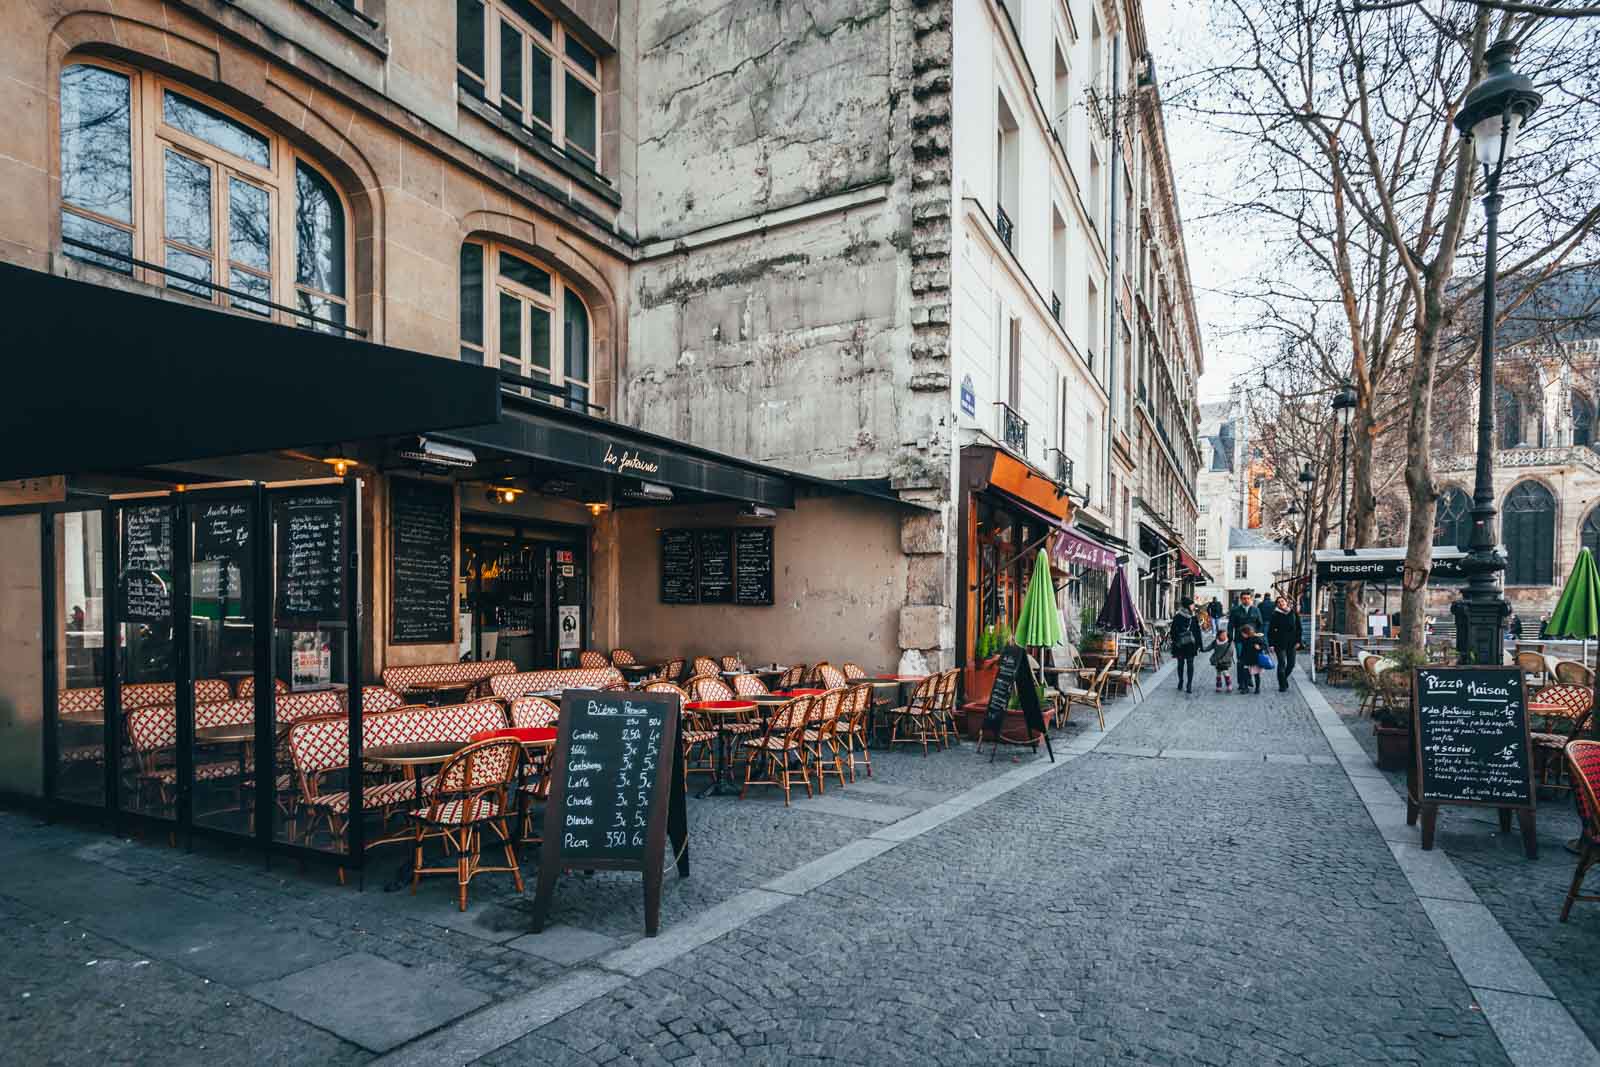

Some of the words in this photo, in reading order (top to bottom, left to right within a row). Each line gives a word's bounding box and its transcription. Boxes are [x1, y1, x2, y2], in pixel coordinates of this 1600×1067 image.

[1330, 563, 1384, 573] brasserie
[566, 814, 594, 826] Blanche
[565, 833, 589, 848] Picon
